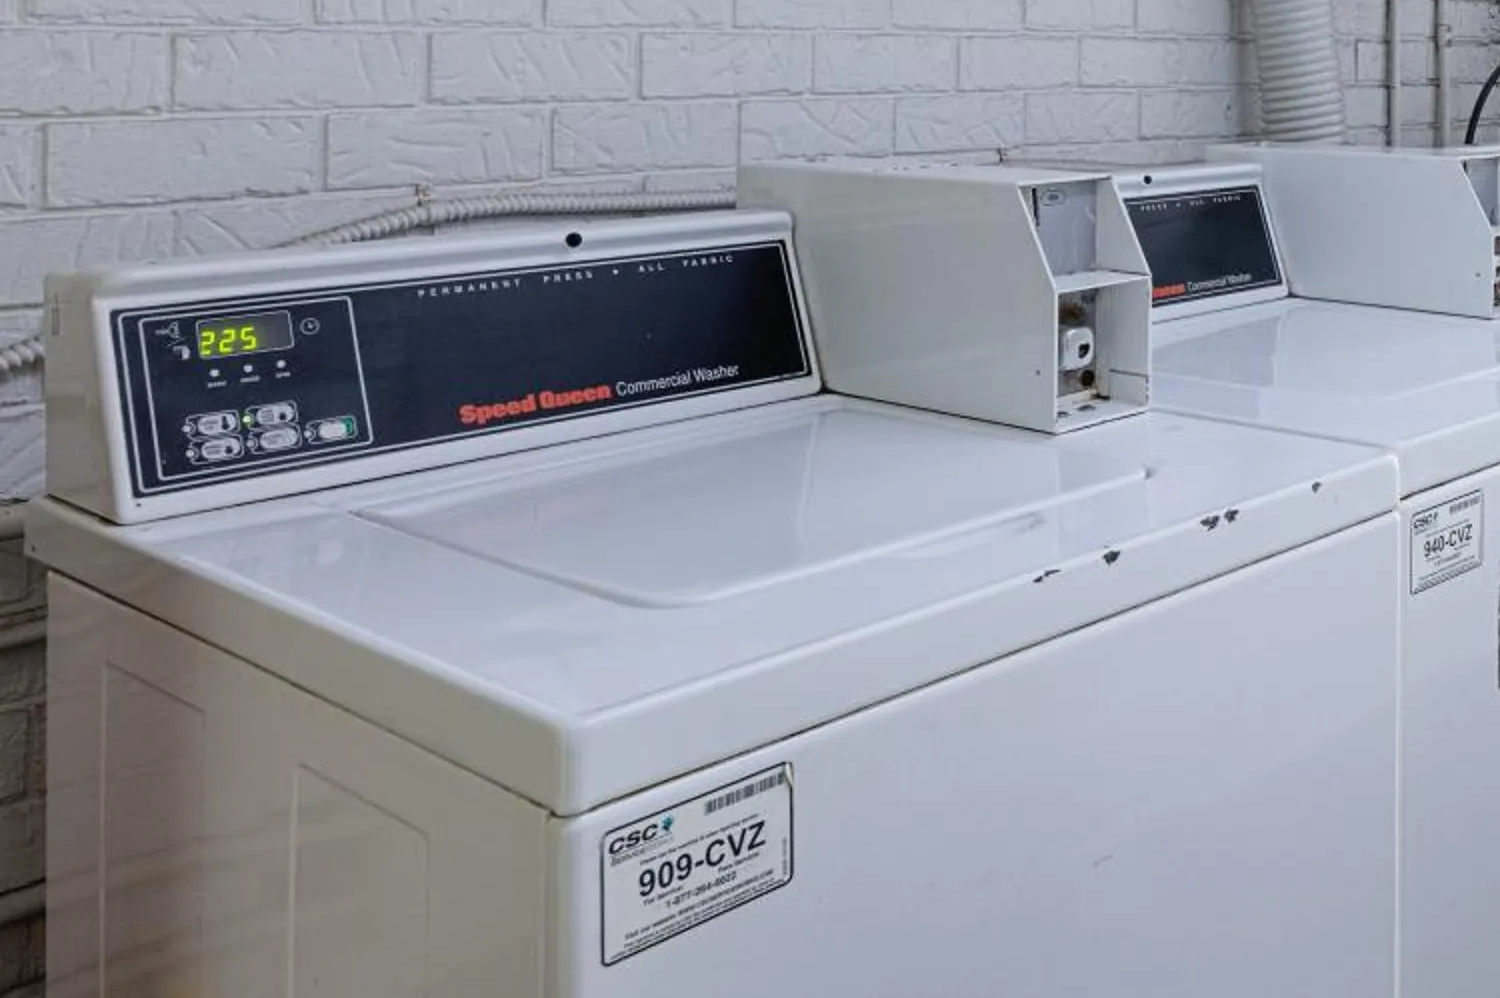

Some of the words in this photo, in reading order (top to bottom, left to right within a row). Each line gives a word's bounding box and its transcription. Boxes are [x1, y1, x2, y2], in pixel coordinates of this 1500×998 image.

[417, 278, 521, 298] PERMANENT
[543, 270, 593, 284] PRESS
[638, 261, 665, 273] ALL
[682, 255, 733, 268] FABRIC
[201, 326, 257, 356] 225
[459, 393, 537, 425] Speed
[540, 384, 612, 409] Queen
[616, 369, 691, 396] Commercial
[693, 363, 740, 381] Washer
[1423, 523, 1473, 558] 940-CVZ
[608, 823, 658, 855] CSC
[639, 820, 766, 897] 909-CVZ
